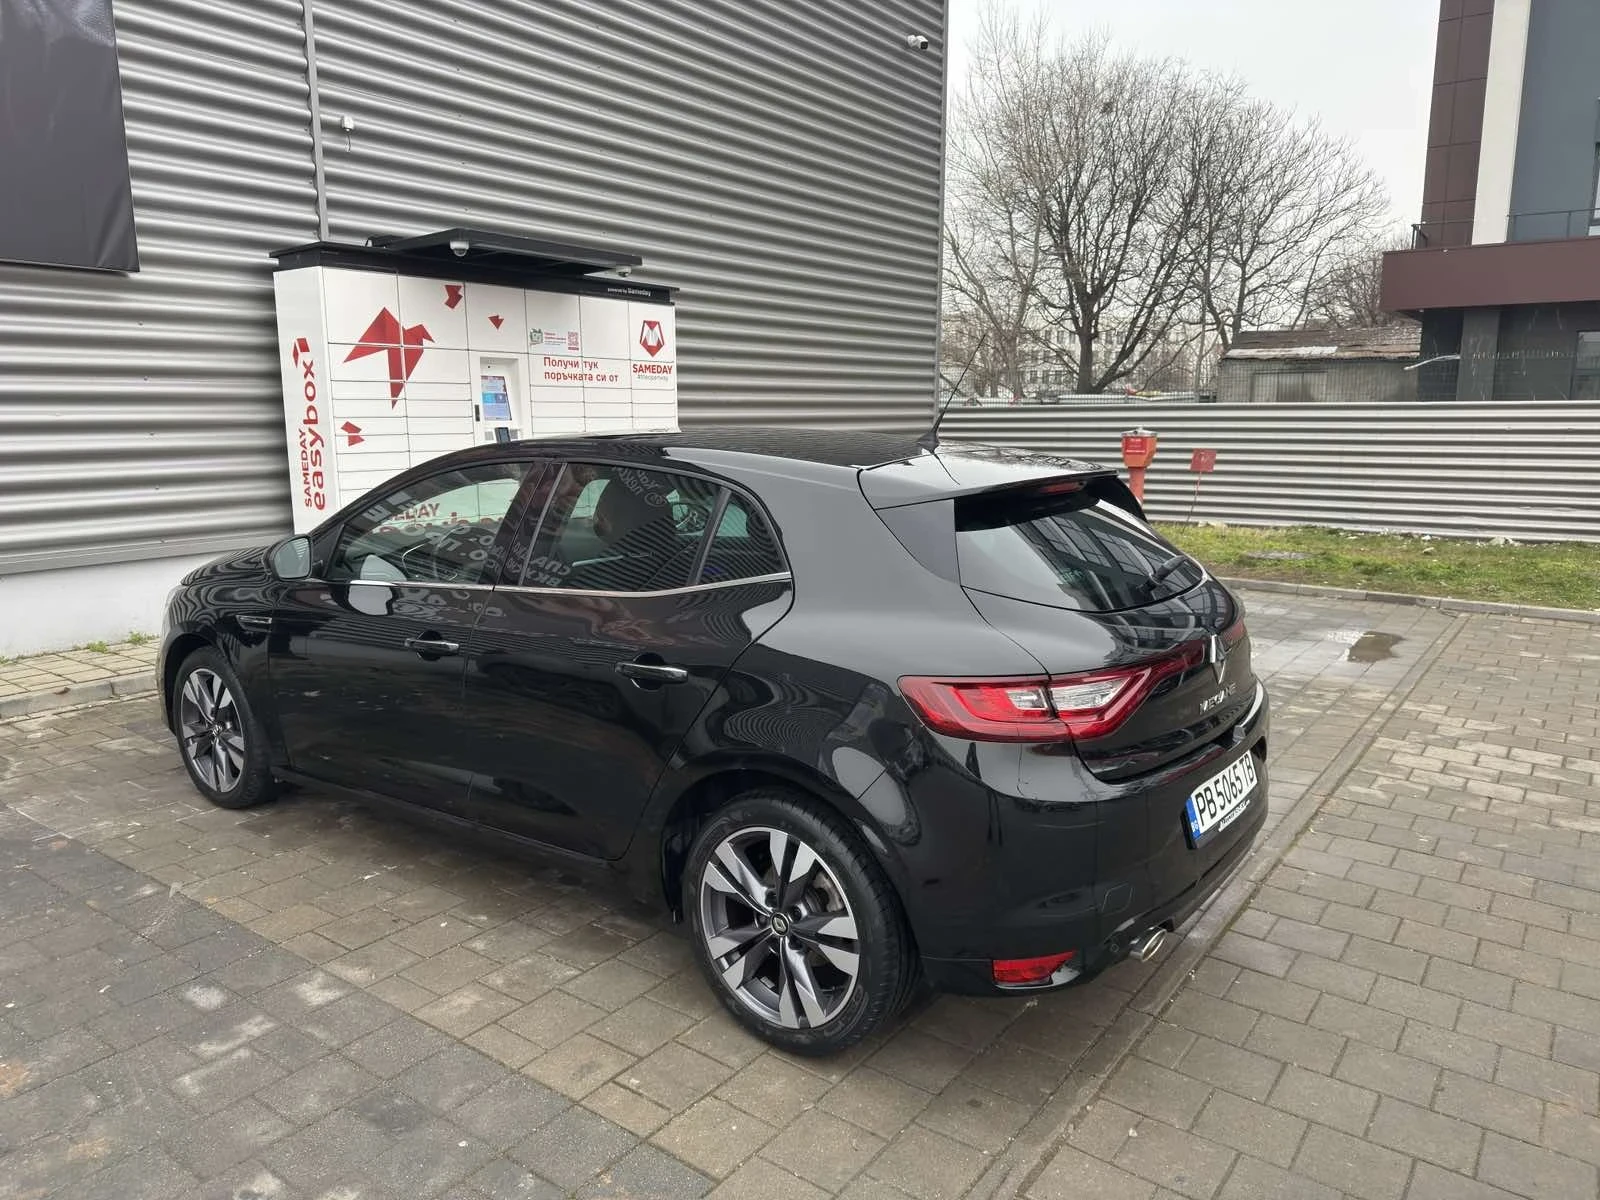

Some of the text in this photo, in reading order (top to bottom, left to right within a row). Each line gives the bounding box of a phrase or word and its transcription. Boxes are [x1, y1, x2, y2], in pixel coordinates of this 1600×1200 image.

[543, 356, 598, 371] Получи тук
[544, 370, 619, 382] поръчката си от
[632, 363, 673, 375] SAMEDAY
[302, 359, 326, 511] easybox
[299, 428, 313, 508] SAMEDAY
[1195, 785, 1217, 827] PB
[1213, 764, 1243, 811] 5065
[1238, 753, 1255, 788] TB
